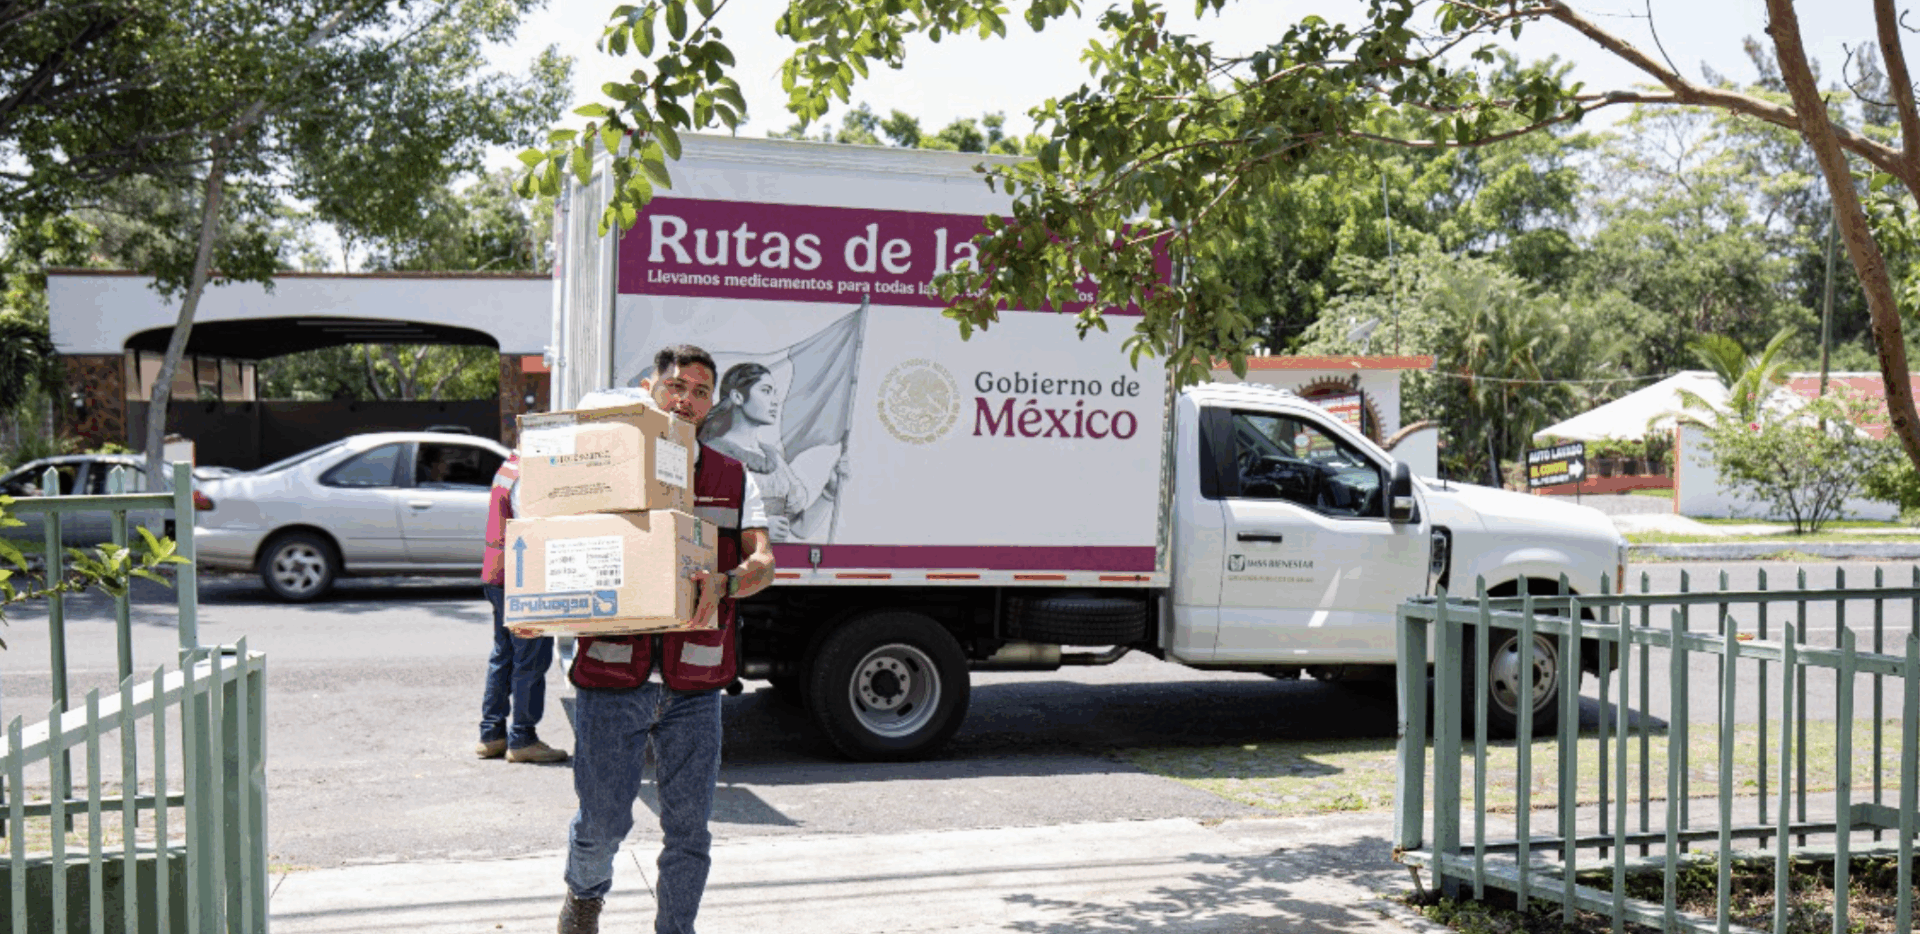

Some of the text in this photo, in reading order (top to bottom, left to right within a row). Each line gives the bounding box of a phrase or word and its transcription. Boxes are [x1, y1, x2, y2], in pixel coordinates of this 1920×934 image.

[648, 214, 980, 276] Rutas de la
[647, 269, 721, 286] Llevamos
[724, 273, 834, 291] medicamentos
[837, 280, 870, 295] para
[875, 281, 914, 295] todas
[919, 280, 938, 296] las
[974, 371, 1140, 398] Gobierno de
[972, 397, 1138, 440] México
[1529, 443, 1583, 463] AUTO LAVADO
[1269, 560, 1314, 569] BIENESTAR
